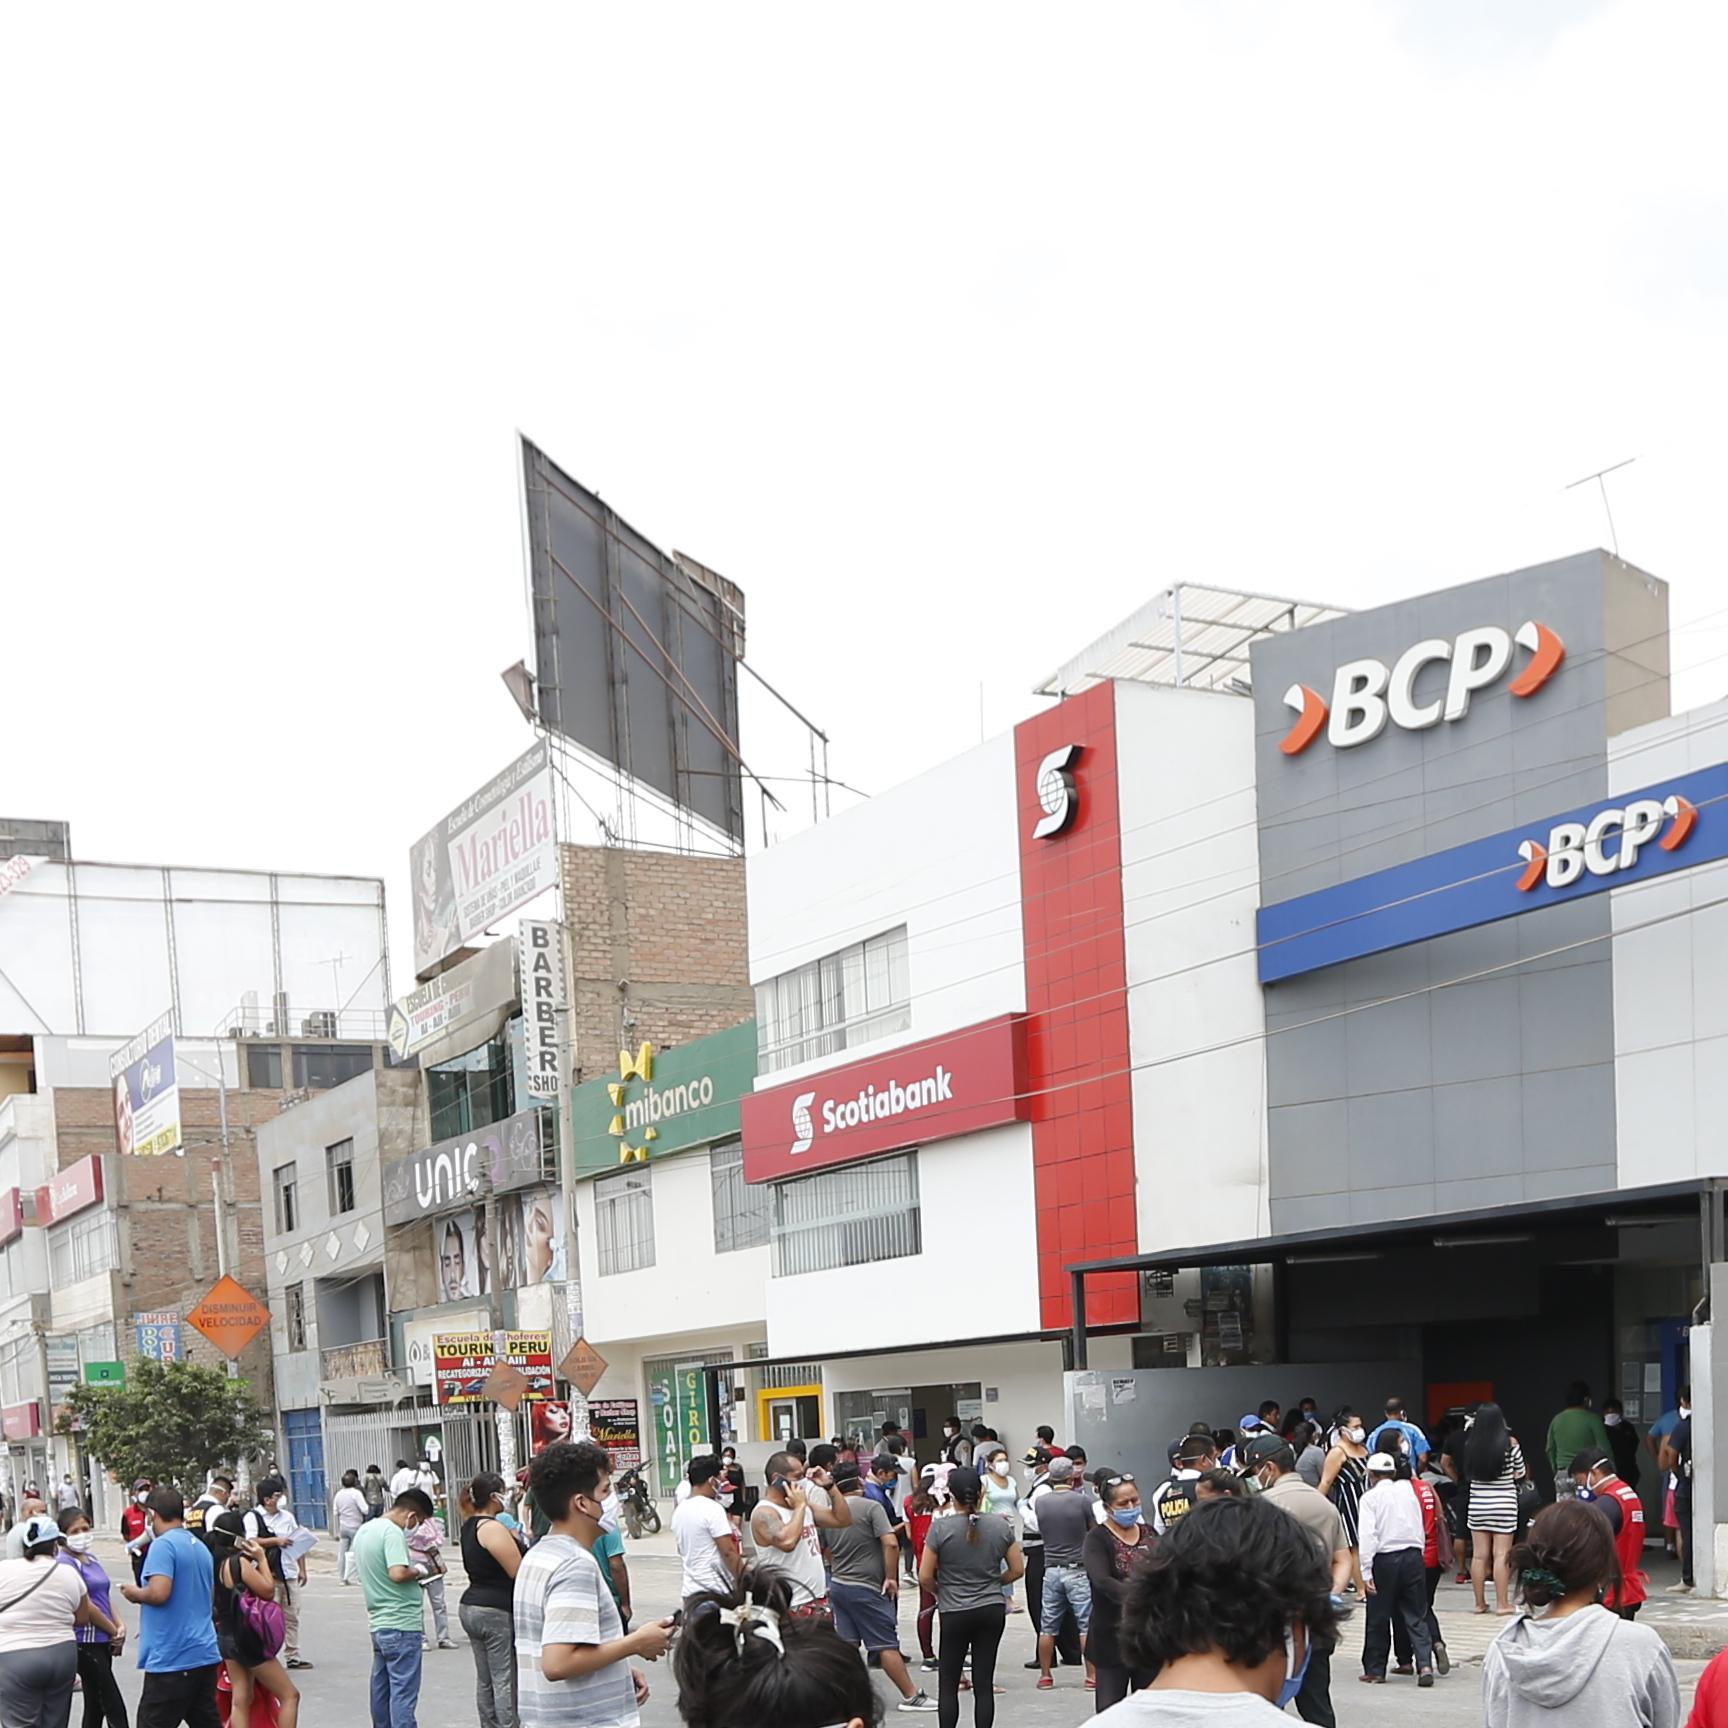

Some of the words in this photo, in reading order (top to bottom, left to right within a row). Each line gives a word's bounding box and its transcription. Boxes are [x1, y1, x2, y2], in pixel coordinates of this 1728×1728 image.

[1327, 626, 1513, 748] BCP
[456, 791, 549, 898] Mariella
[1546, 800, 1664, 888] BCP
[531, 926, 558, 1072] BARBER
[533, 1075, 558, 1092] SHO
[625, 1076, 713, 1131] mibanco
[822, 1065, 953, 1133] Scotiabank
[201, 1303, 256, 1313] DISMINUIR
[199, 1316, 261, 1328] VELOCIDAD
[438, 1335, 480, 1344] Escuela
[506, 1332, 548, 1341] hoferes
[438, 1343, 494, 1356] TOURIN
[510, 1341, 548, 1354] PERU
[462, 1358, 474, 1366] AI
[483, 1357, 495, 1366] AI
[438, 1369, 492, 1379] RECATEGORIZAC
